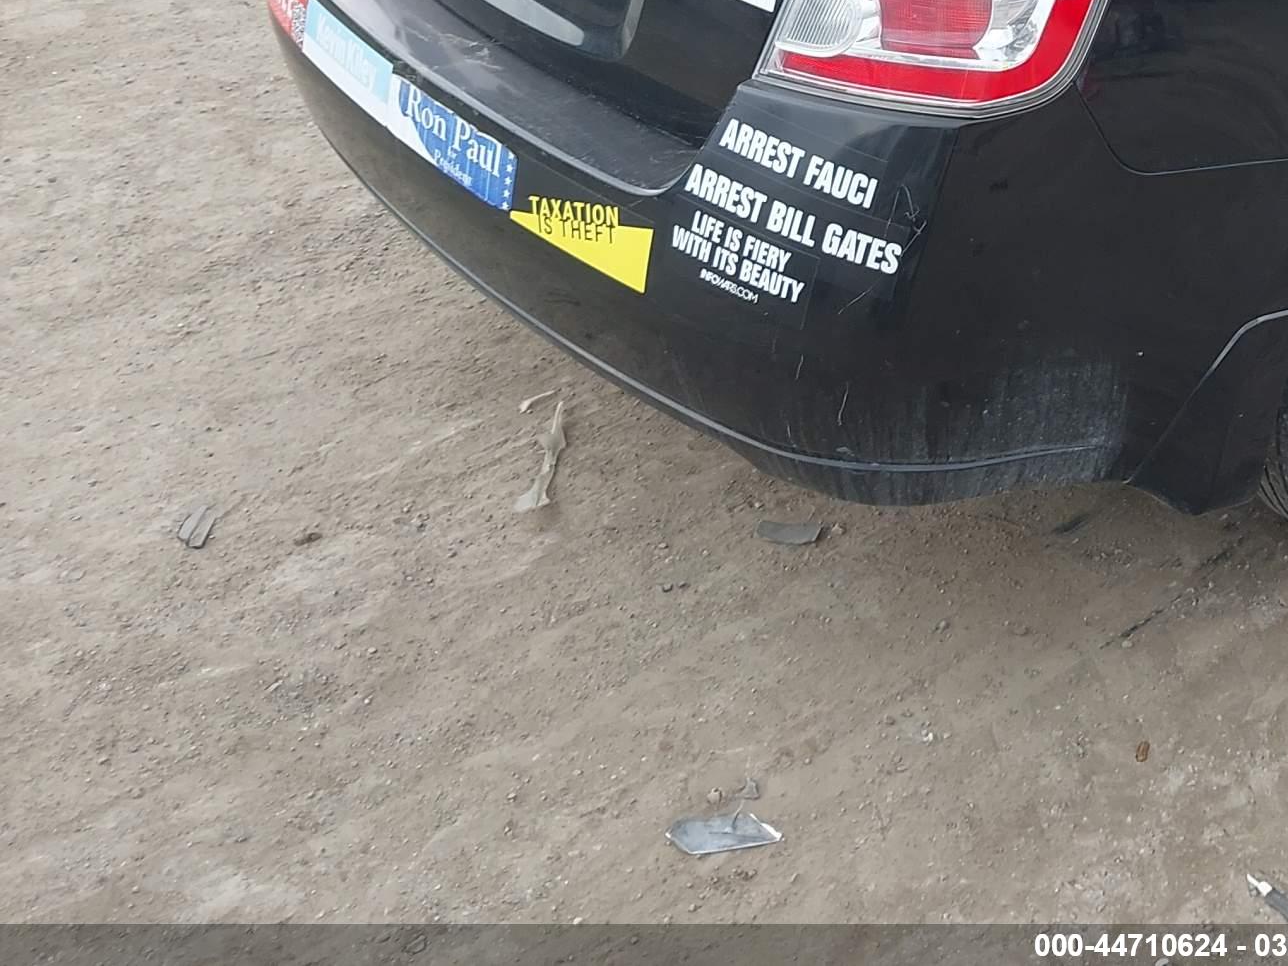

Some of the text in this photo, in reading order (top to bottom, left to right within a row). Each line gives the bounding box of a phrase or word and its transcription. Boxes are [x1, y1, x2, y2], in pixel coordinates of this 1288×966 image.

[405, 84, 502, 178] Ron Paul
[719, 118, 879, 210] ARREST FAUCI
[528, 195, 619, 227] TAXATION
[538, 215, 616, 244] IS THEFT
[684, 163, 903, 275] ARREST BILL GATES
[690, 210, 792, 274] LIFE IS FIERY
[671, 224, 806, 304] WITH ITS BEAUTY
[699, 268, 760, 304] INFOWARS.COM
